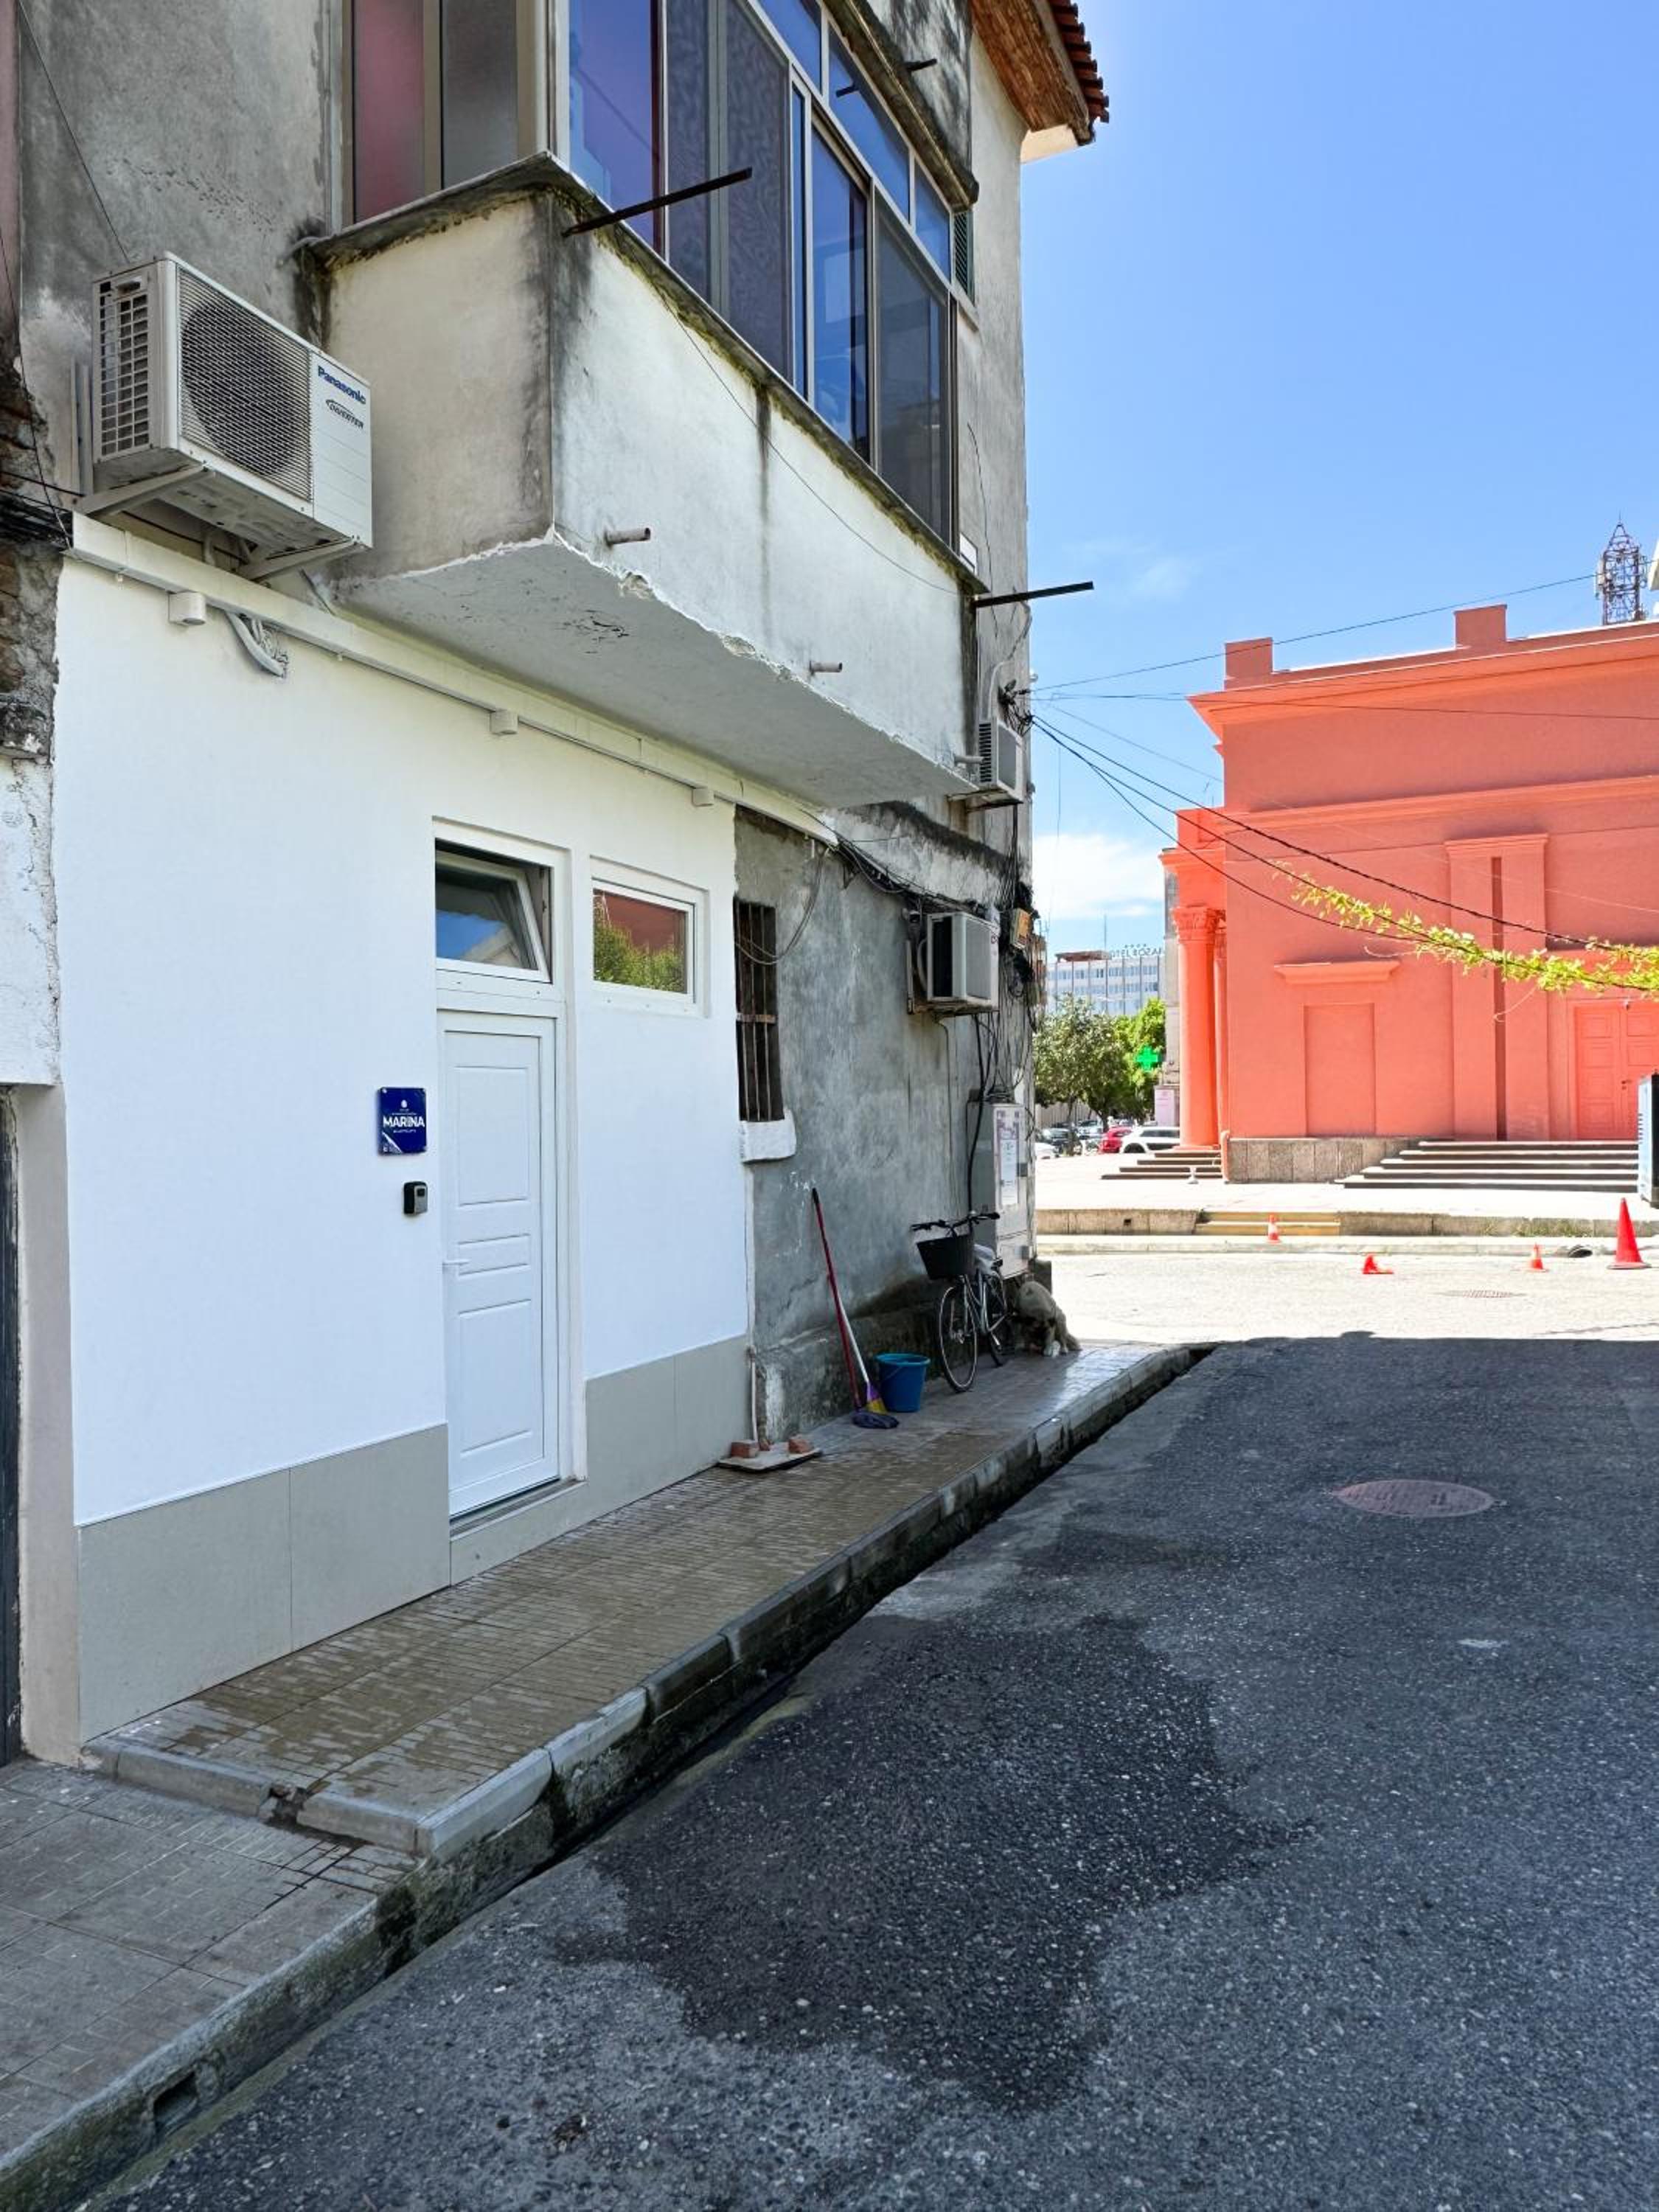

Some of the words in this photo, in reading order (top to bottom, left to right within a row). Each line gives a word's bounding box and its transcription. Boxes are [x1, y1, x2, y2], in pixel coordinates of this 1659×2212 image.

[318, 365, 366, 405] Panasonic
[326, 399, 364, 429] INVERTER
[383, 1116, 425, 1128] MARINA
